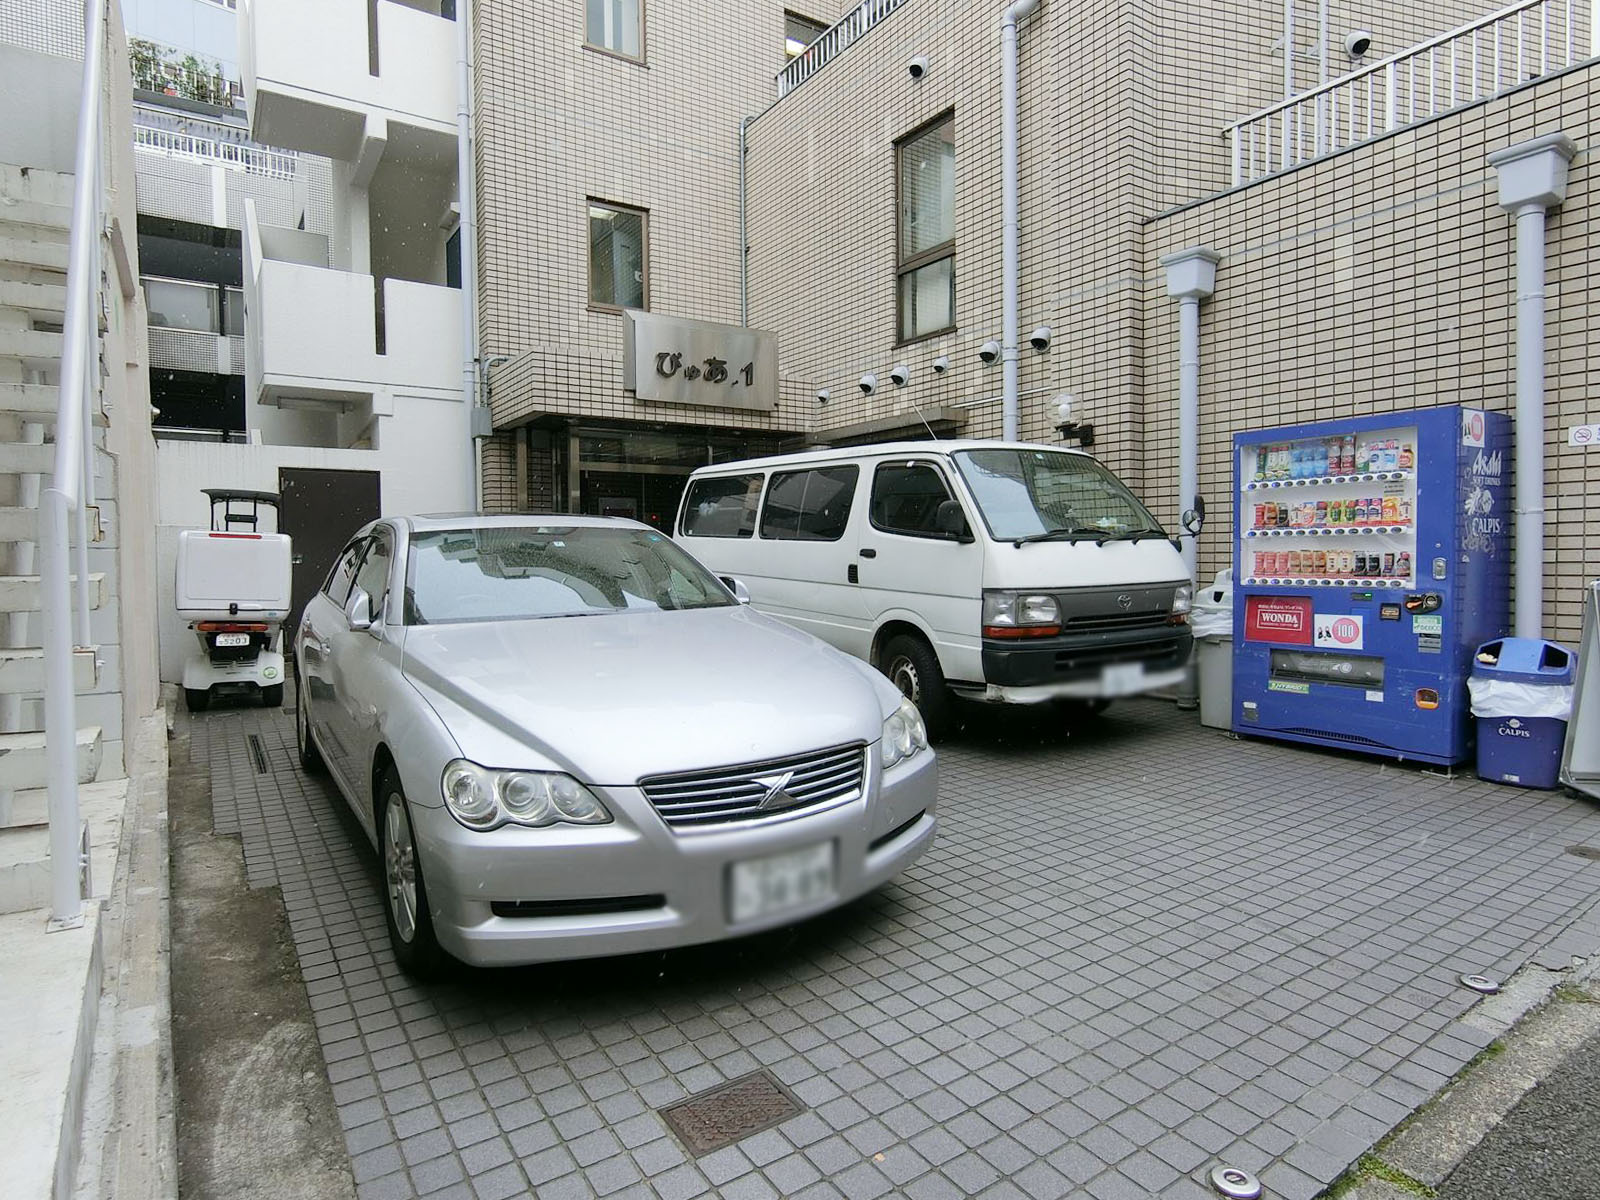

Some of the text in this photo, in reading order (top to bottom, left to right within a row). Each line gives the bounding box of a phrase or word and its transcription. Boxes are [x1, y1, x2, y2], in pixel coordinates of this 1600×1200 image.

[1473, 448, 1502, 477] Asahi
[1472, 517, 1500, 536] CALPIS
[1261, 612, 1299, 624] WONDA
[1337, 624, 1355, 638] 100
[1498, 727, 1530, 738] CALPIS
